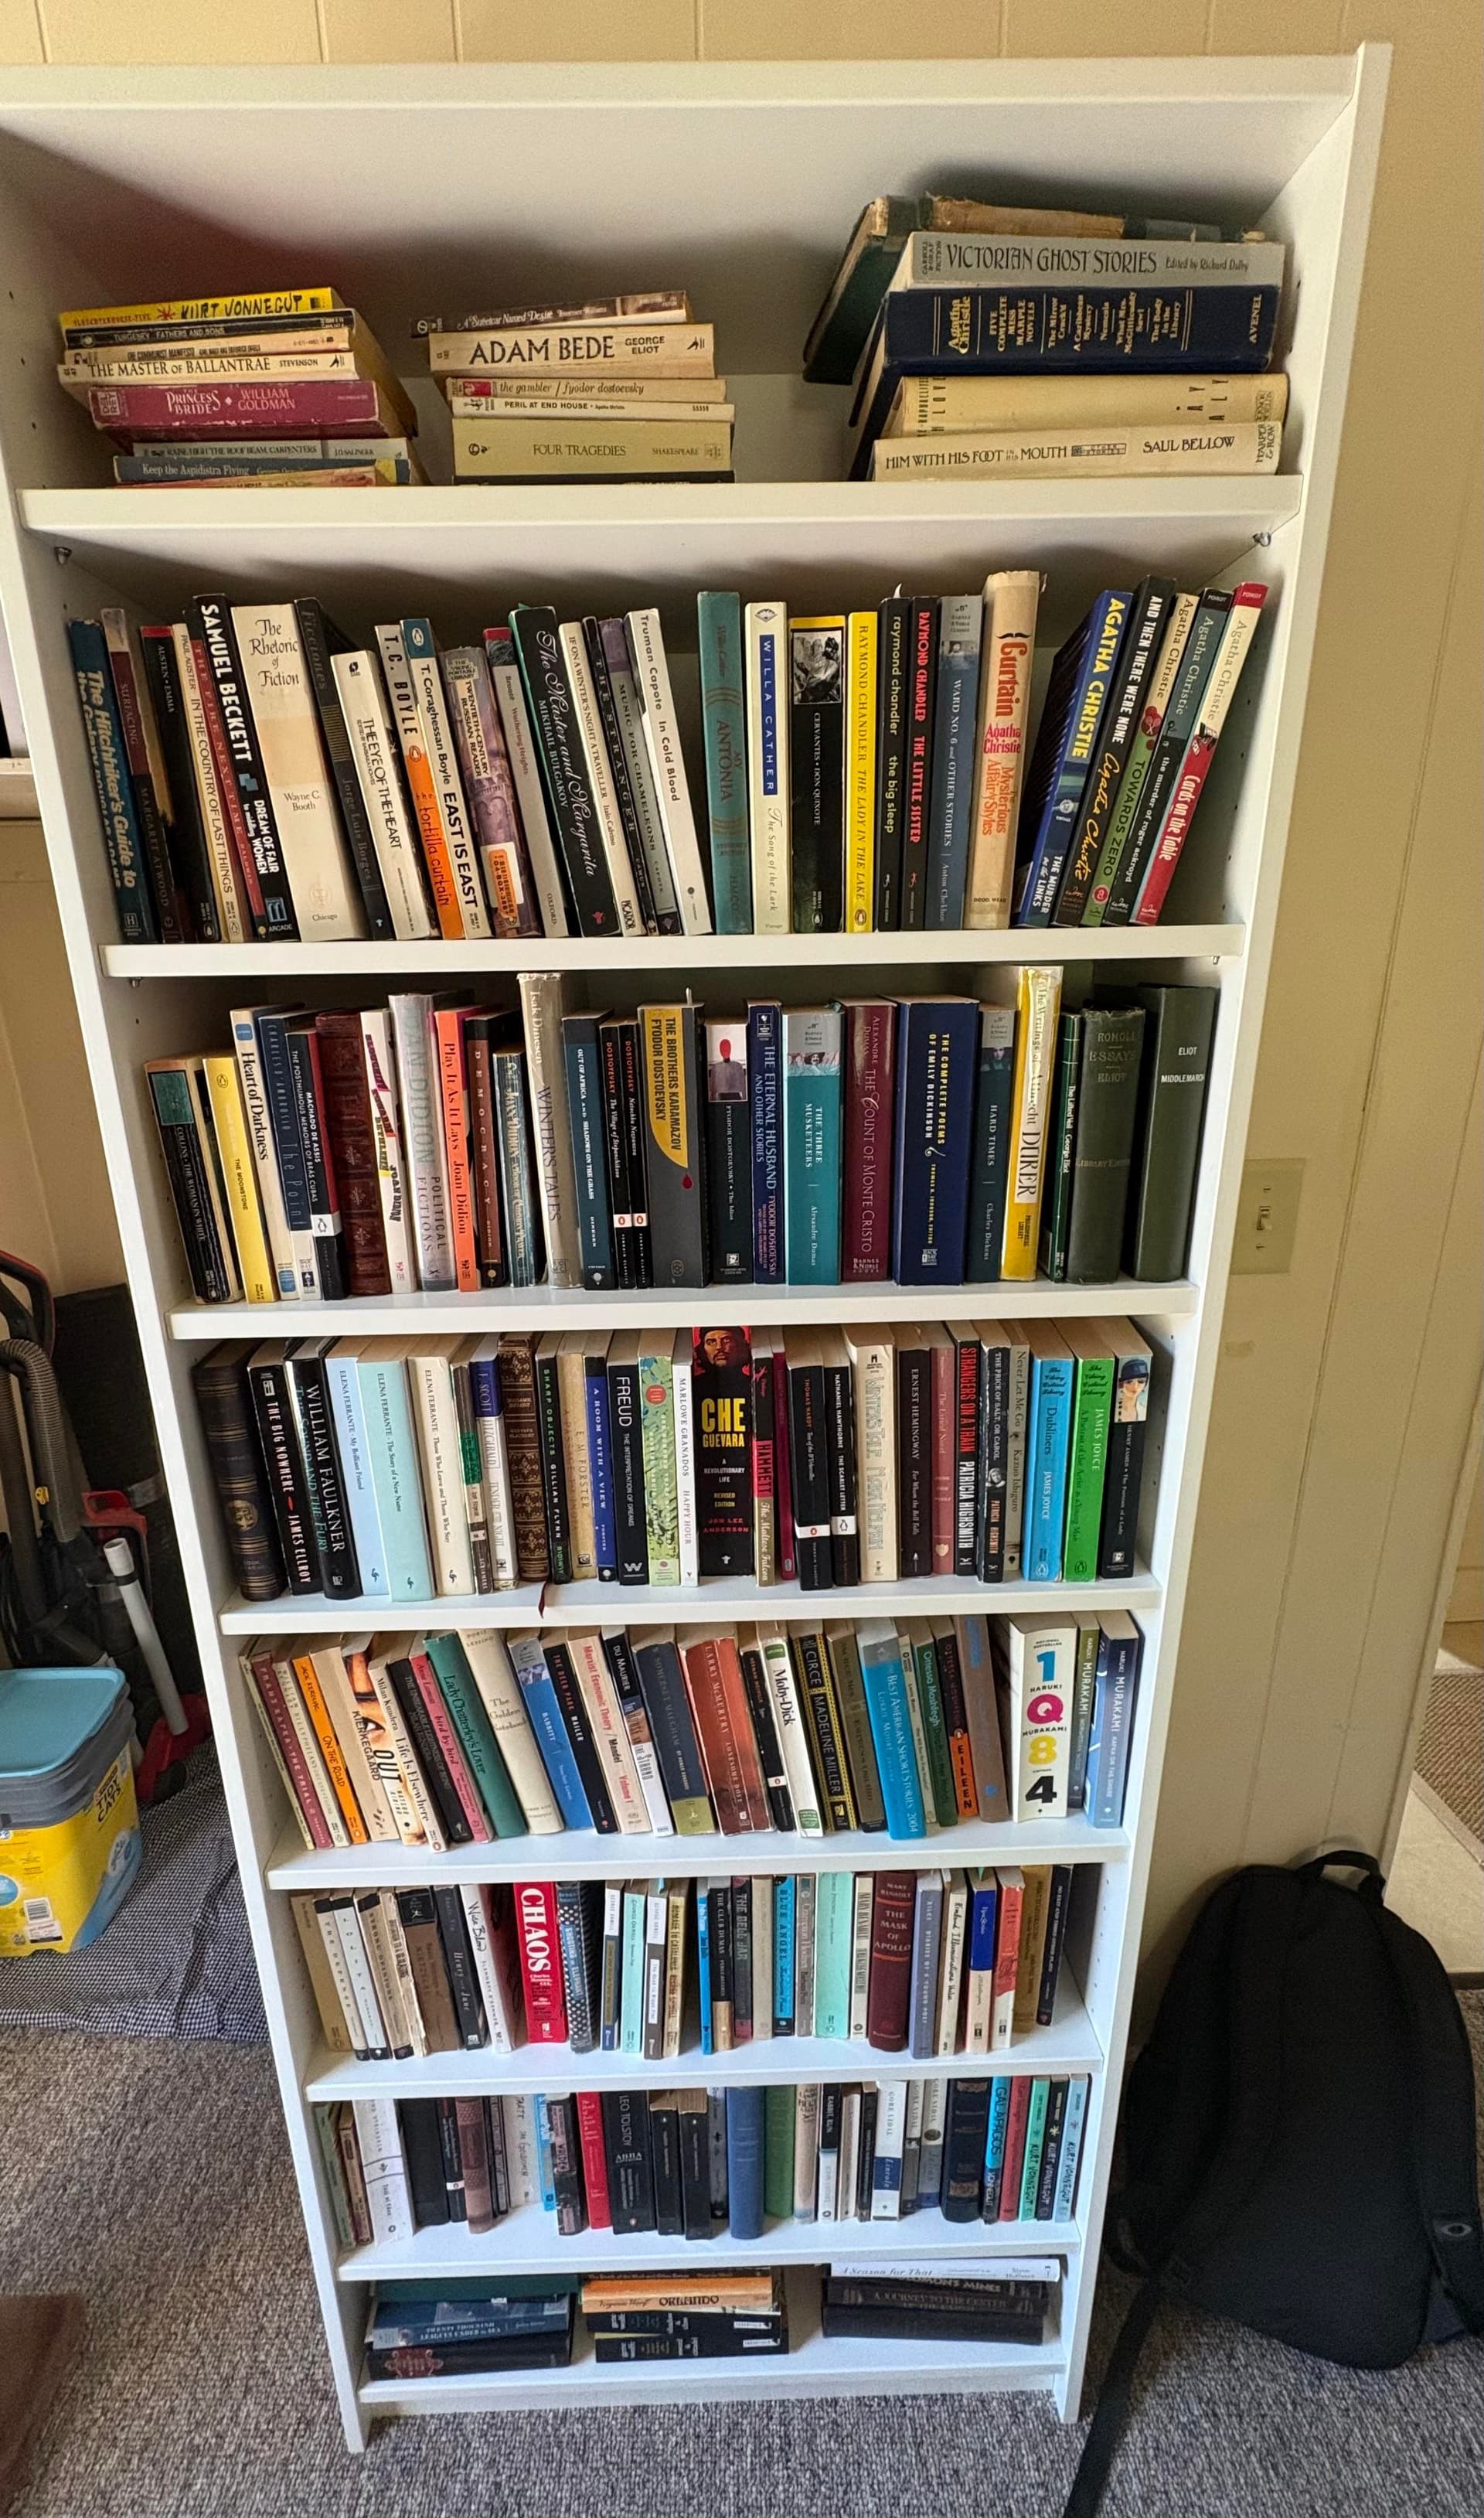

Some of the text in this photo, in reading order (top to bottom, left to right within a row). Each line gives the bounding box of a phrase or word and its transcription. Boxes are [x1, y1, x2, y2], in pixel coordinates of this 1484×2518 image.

[948, 244, 1157, 274] VICTORIAN GHOST STORIES
[224, 295, 303, 318] VONNEGUT
[948, 298, 961, 349] Agatha
[1250, 295, 1262, 345] AVENEL
[625, 336, 665, 346] GEORGE
[959, 295, 970, 354] Christie
[469, 336, 615, 365] ADAM BEDE
[631, 346, 659, 354] ELIOT
[90, 358, 318, 377] THE MASTER OF BALLANTRAE STEVENSON
[167, 390, 220, 413] PRINCESS
[238, 399, 295, 411] GOLDMAN
[240, 388, 289, 400] WILLIAM
[500, 383, 644, 398] the gambler fyodor dostoevsky
[175, 404, 213, 414] BRIDE
[534, 445, 626, 456] FOUR TRAGEDIES
[886, 446, 1067, 469] HIM WITH HIS FOOT MOUTH
[1143, 436, 1234, 454] SAUL BELLOW
[256, 619, 282, 635] The
[250, 639, 298, 656] Rhetoric
[272, 656, 279, 668] of
[640, 615, 662, 710] Truman Capote
[202, 604, 252, 762] SAMUEL BECKETT
[258, 671, 299, 687] Fiction
[890, 615, 901, 735] raymond chandler
[914, 612, 930, 721] RAYMOND CHANDLER
[996, 642, 1027, 717] Curtain
[1073, 598, 1126, 758] AGATHA CHRISTIE
[1111, 596, 1163, 744] AND THEN THERE WERE NONE
[763, 641, 774, 791] WILLA CATHER
[985, 723, 1021, 740] Agatha
[539, 700, 567, 809] MIKHAIL BULGAKOV
[659, 721, 679, 801] In Cold Blood
[855, 625, 869, 900] RAYMOND CHANDLER THE LADY IN THE LAKE
[983, 738, 1021, 754] Christie
[87, 671, 104, 707] The
[114, 814, 132, 866] Guide
[124, 867, 135, 888] to
[192, 699, 232, 894] IN THE COUNTRY OF LAST THINGS
[884, 777, 897, 799] big
[910, 736, 925, 843] THE LITTLE SISTER
[284, 792, 308, 802] Wayne
[292, 801, 315, 811] Booth
[884, 802, 896, 833] sleep
[1104, 761, 1146, 877] TOWARDS ZERO
[419, 806, 449, 906] tortilla curtain
[444, 792, 478, 907] EAST IS EAST
[1179, 1047, 1196, 1056] ELIOT
[651, 1019, 665, 1121] FYODOR DOSTOEVSKY
[665, 1017, 681, 1150] THE BROTHERS KARAMAZOV
[241, 1052, 268, 1160] Heart of Darkness
[804, 1103, 812, 1168] MUSKETEERS
[987, 1105, 997, 1166] HARD TIMES
[545, 1172, 561, 1222] TALES
[961, 1348, 976, 1401] STRANGERS
[617, 1377, 631, 1426] FREUD
[702, 1398, 746, 1432] CHE
[961, 1405, 975, 1416] ON
[267, 1402, 294, 1493] THE BIG NOWHERE
[703, 1434, 744, 1448] GUEVARA
[911, 1405, 920, 1460] HEMINGWAY
[961, 1425, 975, 1452] TRAIN
[1044, 1407, 1057, 1454] Dubliners
[305, 1385, 345, 1552] WILLIAM FAULKNER
[1042, 1471, 1050, 1495] JAMES
[958, 1461, 975, 1549] PATRICIA HIGHSMITH
[288, 1515, 311, 1583] JAMES ELLROY
[806, 1652, 821, 1685] CIRCE
[1037, 1651, 1055, 1682] 1
[773, 1670, 795, 1725] Moby-Dick
[1027, 1694, 1064, 1724] Q
[322, 1736, 345, 1787] ON THE ROAD
[352, 1710, 380, 1780] KIERKEGAARD
[815, 1695, 841, 1794] MADELINE MILLER
[1029, 1736, 1057, 1765] 8
[373, 1750, 403, 1784] OUT
[1026, 1776, 1057, 1803] 4
[520, 1888, 551, 1972] CHAOS
[880, 1920, 907, 1930] MASK
[886, 1910, 904, 1919] THE
[874, 1942, 910, 1951] APOLLO
[659, 2295, 719, 2306] ORLANDO
